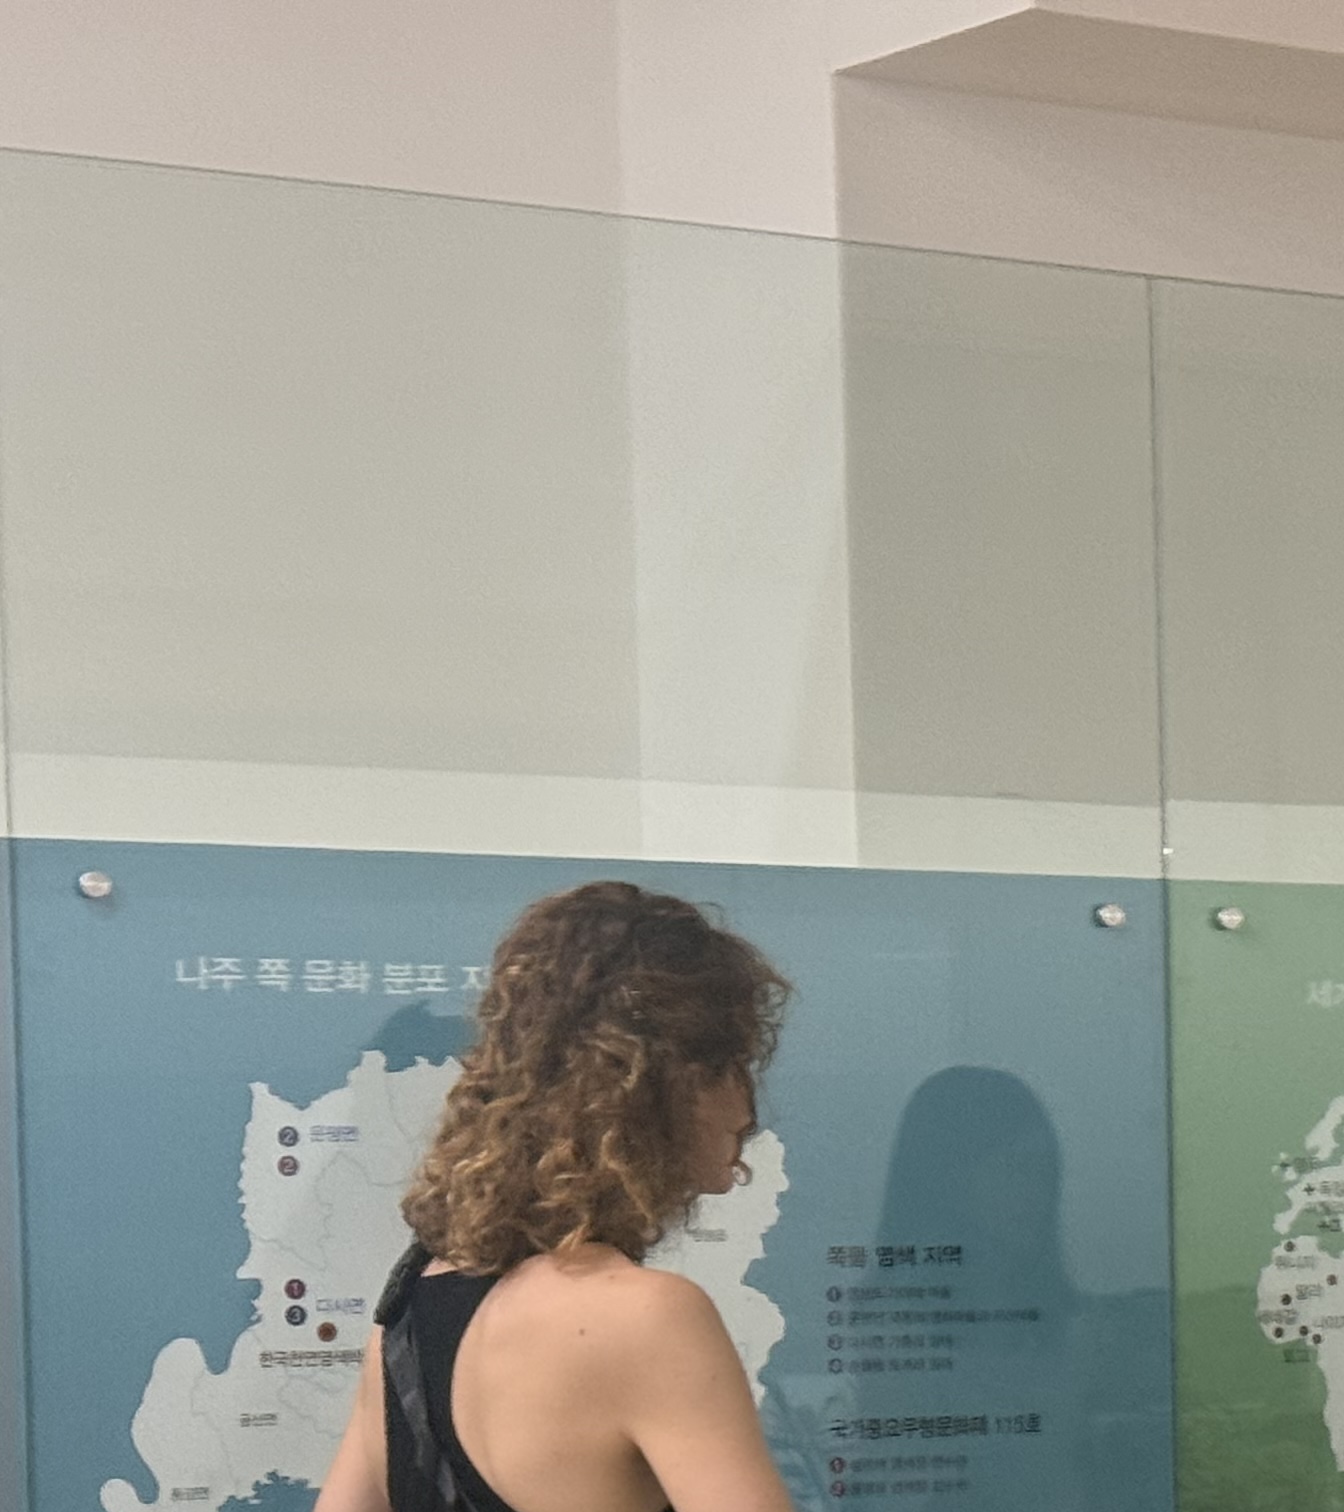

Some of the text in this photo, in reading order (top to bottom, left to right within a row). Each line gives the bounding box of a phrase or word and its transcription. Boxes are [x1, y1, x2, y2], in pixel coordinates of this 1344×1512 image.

[175, 956, 492, 996] 나주 쪽 문화 분포 지
